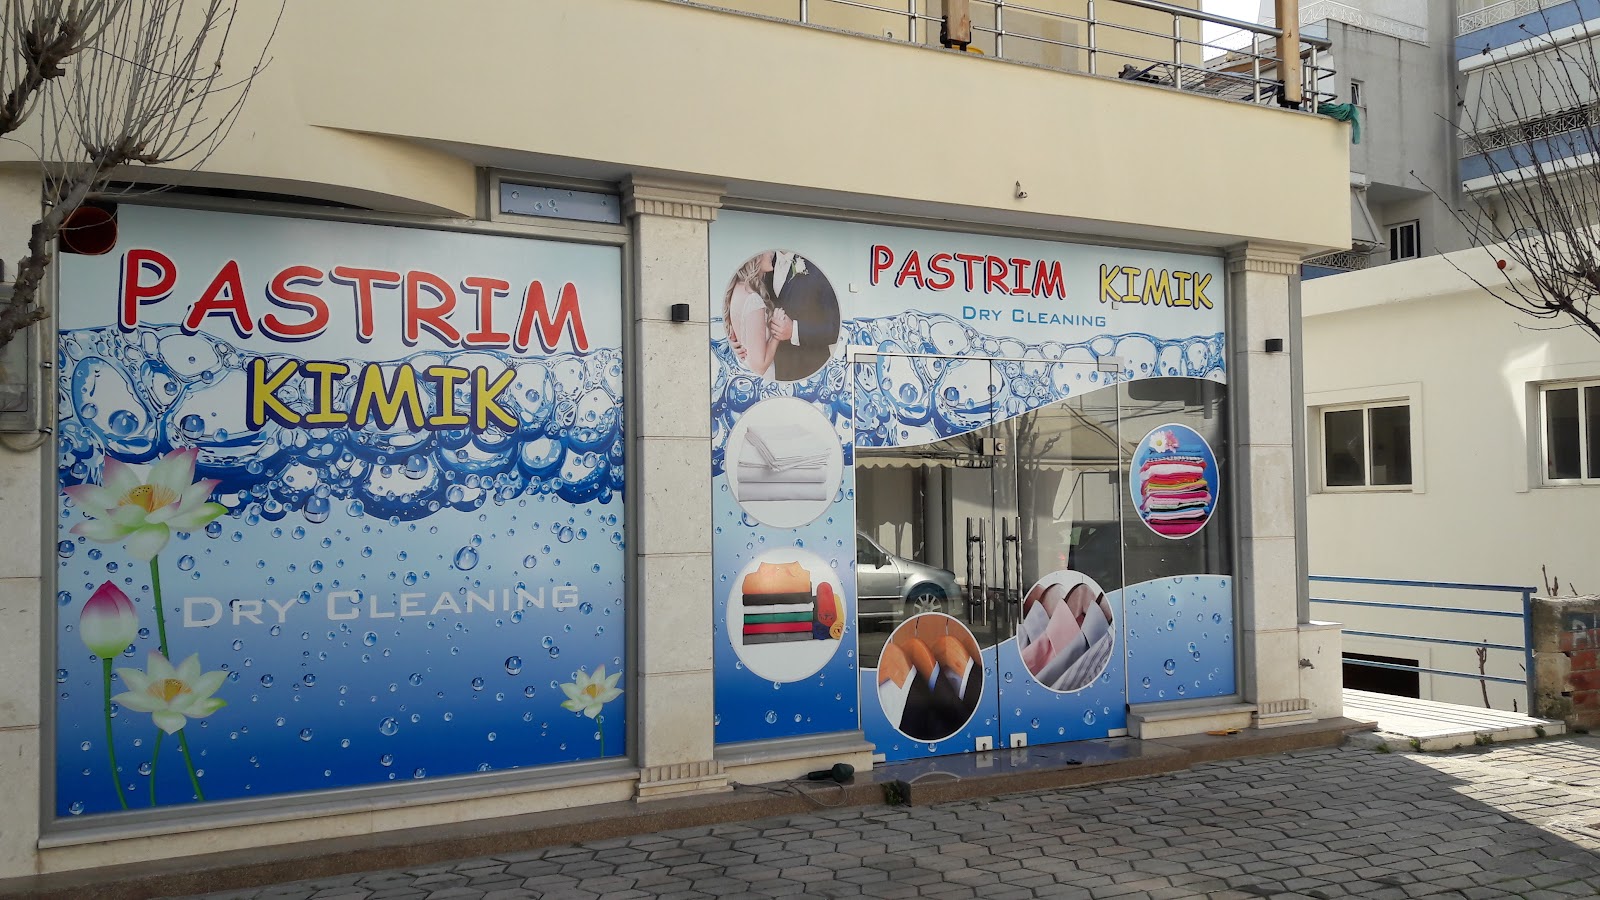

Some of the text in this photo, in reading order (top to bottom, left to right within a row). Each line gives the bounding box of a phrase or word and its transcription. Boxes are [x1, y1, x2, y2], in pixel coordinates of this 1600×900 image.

[118, 248, 588, 354] PASTRIM
[870, 244, 1214, 310] PASTRIM KIMIK
[962, 305, 1107, 328] DRY CLEANING
[246, 358, 519, 431] KIMIK
[183, 585, 579, 628] DRY CLEANING
